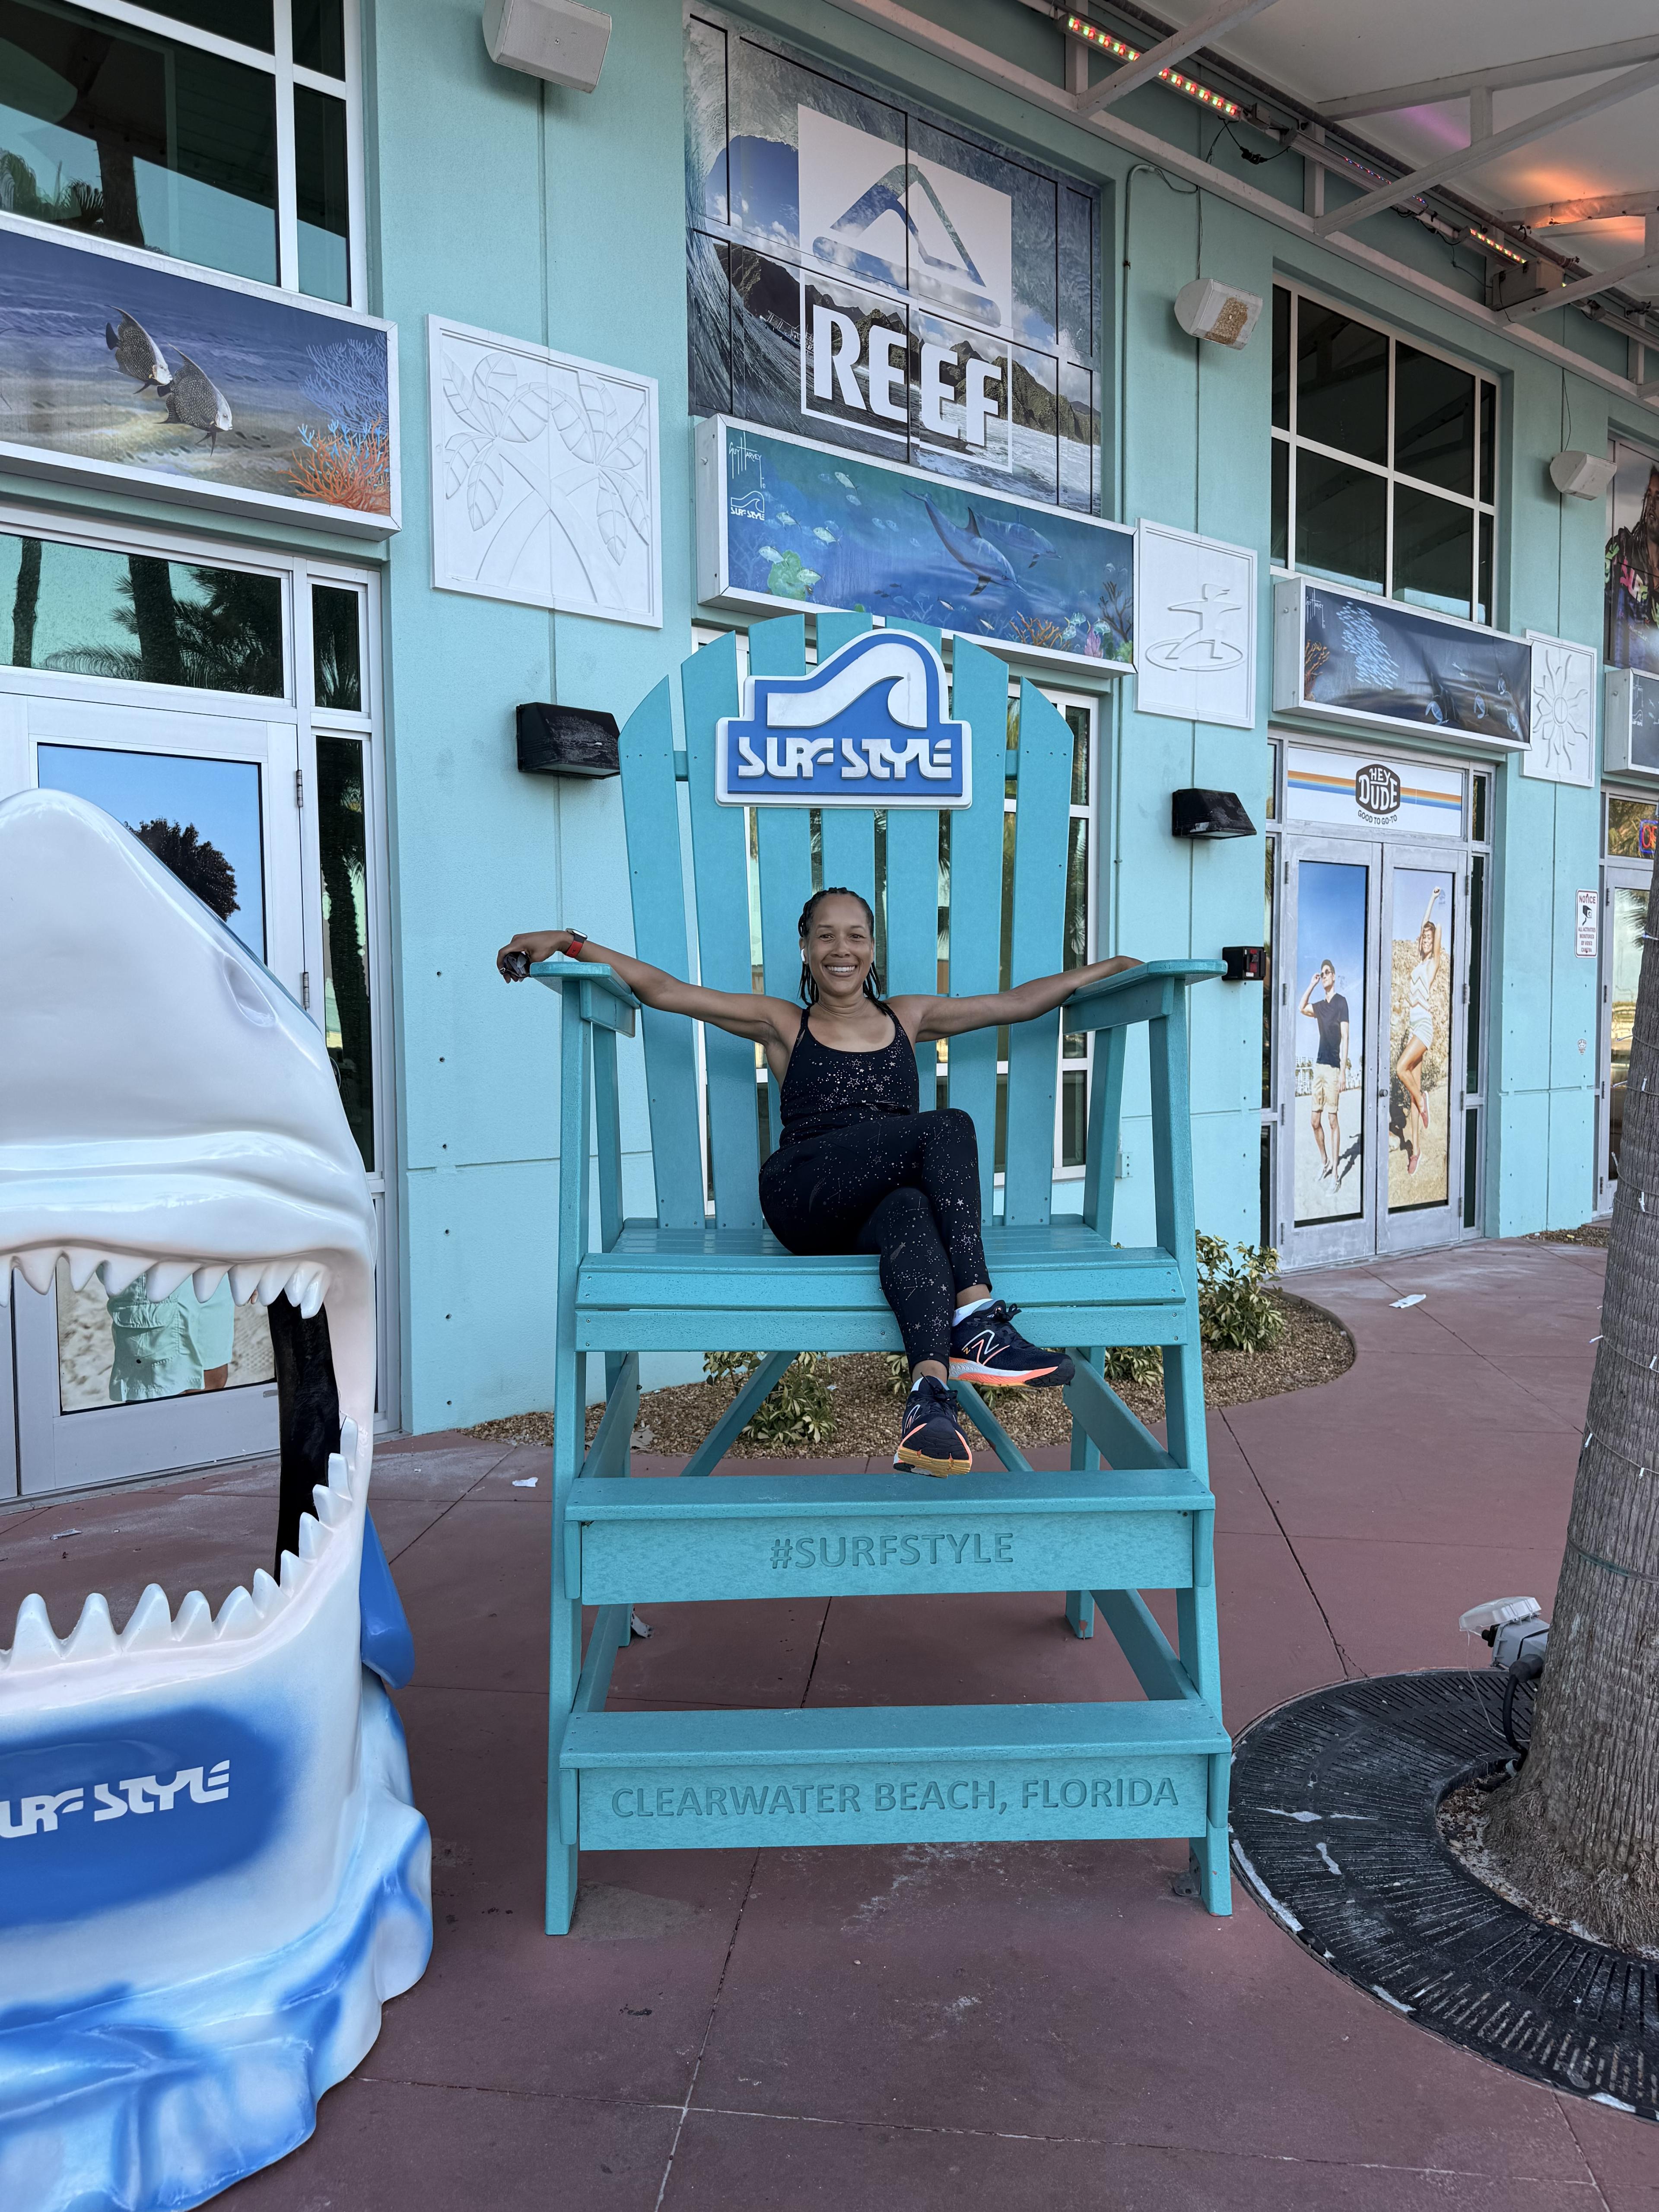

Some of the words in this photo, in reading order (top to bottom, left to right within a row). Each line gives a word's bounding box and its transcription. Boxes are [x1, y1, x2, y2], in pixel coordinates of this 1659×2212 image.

[813, 305, 1001, 447] REEF
[1358, 774, 1398, 811] DUDE
[1369, 767, 1391, 786] HEY
[1358, 810, 1373, 823] GOOD
[1373, 817, 1380, 825] TO
[1579, 896, 1596, 904] NOTICE
[770, 1533, 1014, 1569] #SURFSTYLE
[0, 1787, 84, 1838] URF
[95, 1760, 230, 1822] STYLE
[612, 1784, 861, 1817] CLEARWATER
[874, 1780, 1007, 1815] BEACH,
[1022, 1777, 1179, 1808] FLORIDA
